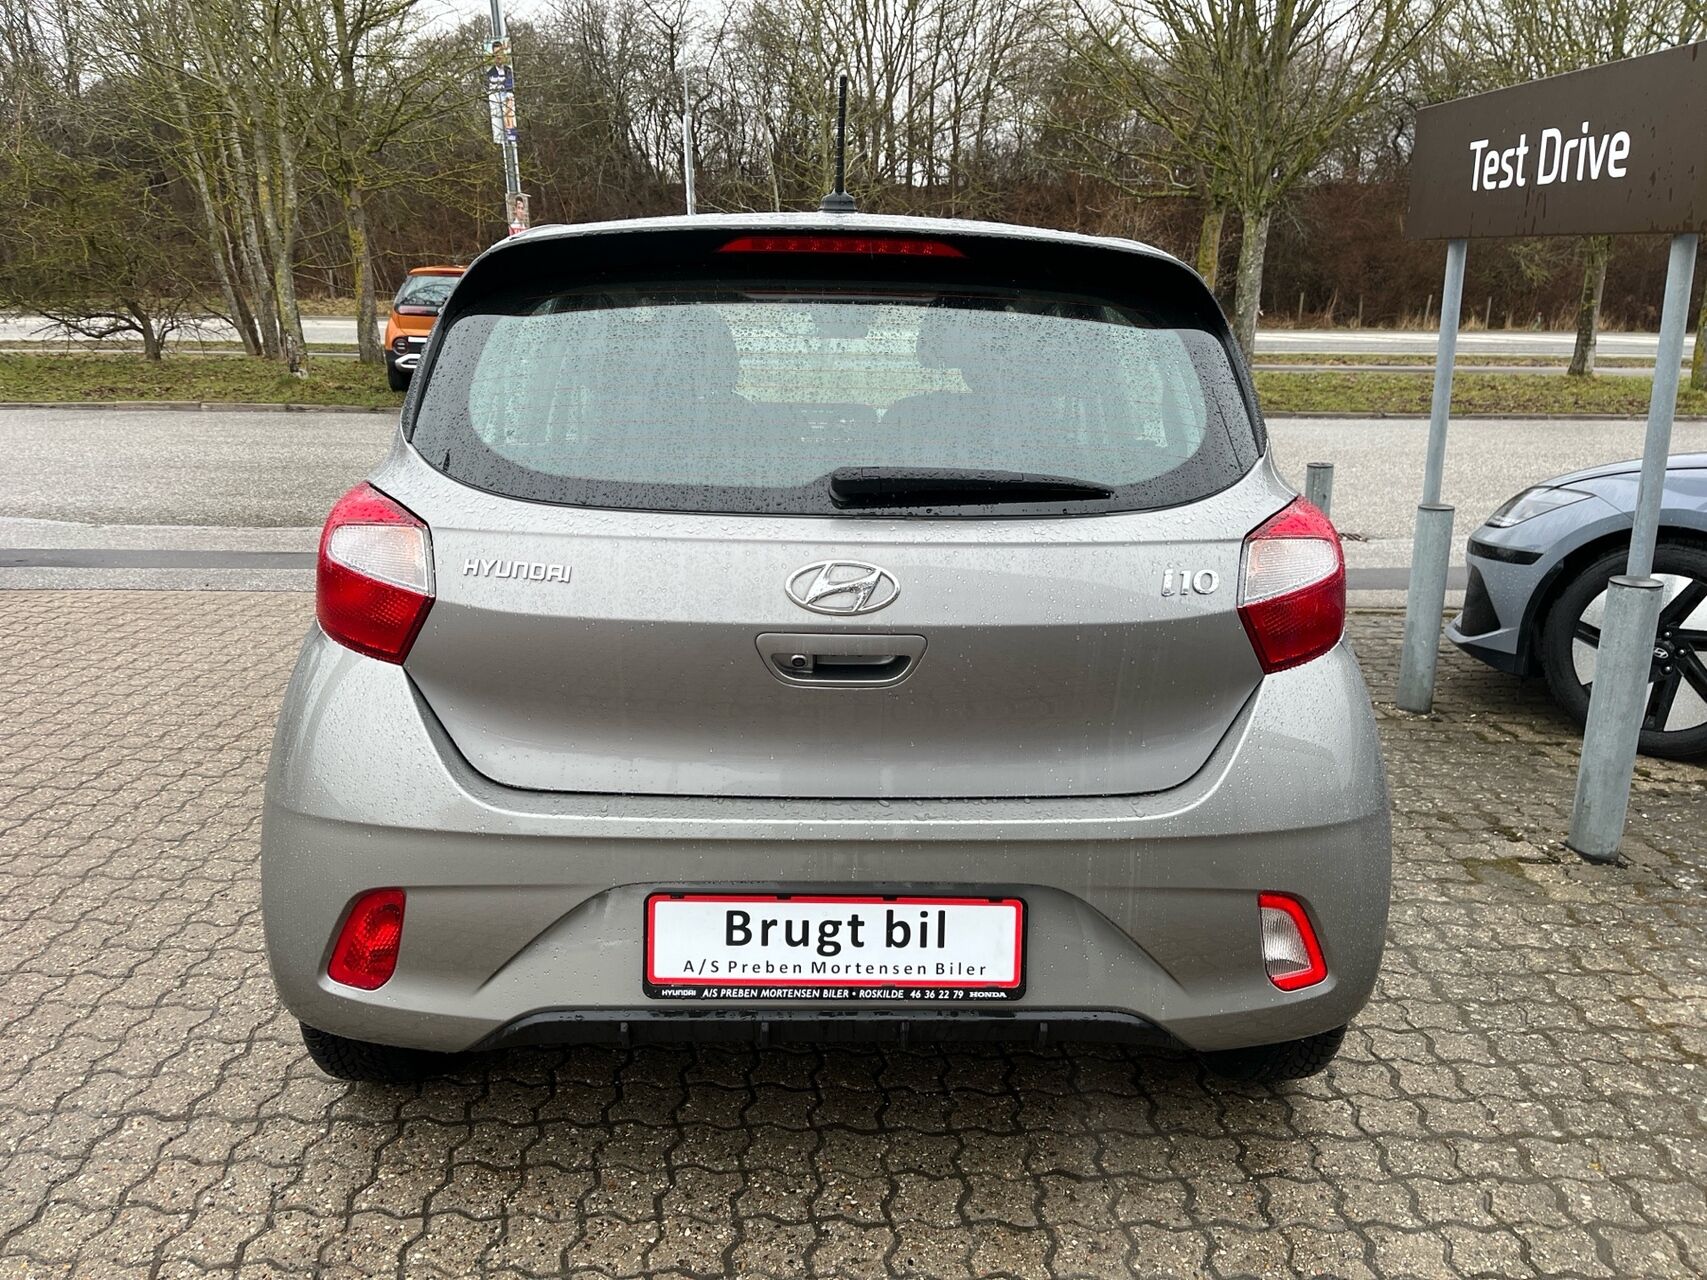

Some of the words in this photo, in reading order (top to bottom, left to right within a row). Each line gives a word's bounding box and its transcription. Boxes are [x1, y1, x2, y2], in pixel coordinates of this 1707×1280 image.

[1469, 133, 1529, 192] Test
[1536, 121, 1631, 186] Drive
[463, 559, 572, 583] HYUNDAI
[1161, 568, 1219, 597] i10
[725, 909, 865, 957] Brugt
[885, 909, 946, 949] bil
[683, 959, 719, 975] A/S
[728, 960, 802, 975] Preben
[811, 961, 927, 976] Mortensen
[936, 962, 987, 976] Biler
[702, 988, 718, 998] A/S
[720, 988, 758, 998] PREBEN
[760, 989, 820, 998] MORTENSEN
[822, 989, 849, 998] BILER
[859, 989, 904, 999] ROSKILDE
[910, 989, 921, 999] 46
[924, 989, 935, 999] 36
[938, 989, 949, 999] 22
[952, 989, 964, 999] 79
